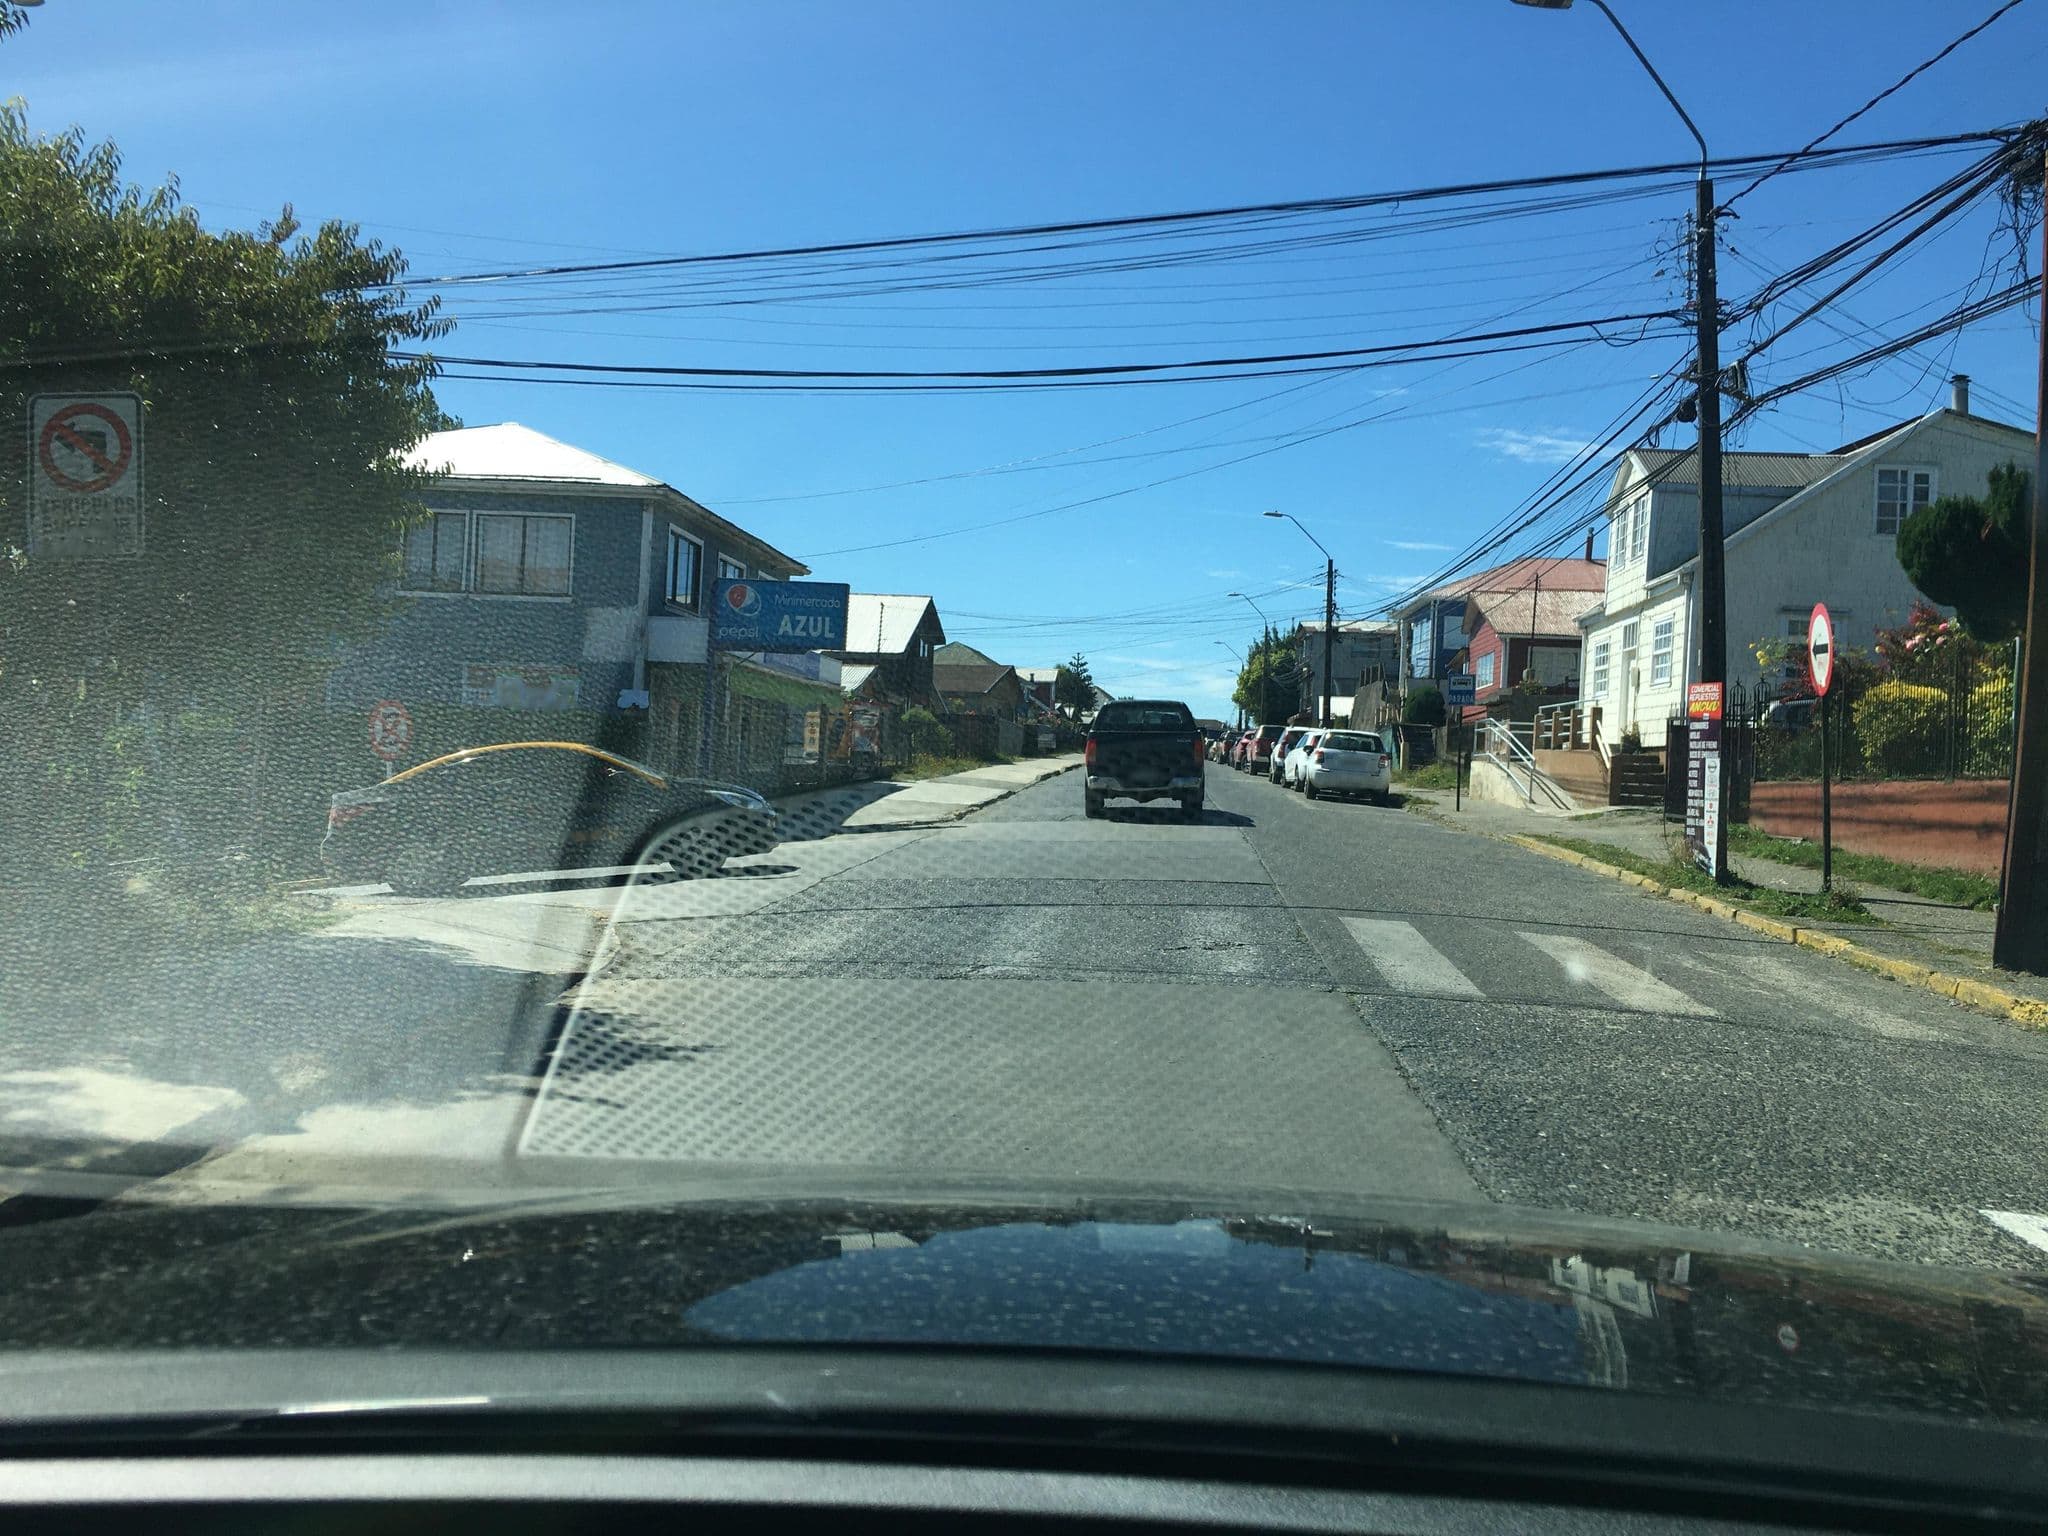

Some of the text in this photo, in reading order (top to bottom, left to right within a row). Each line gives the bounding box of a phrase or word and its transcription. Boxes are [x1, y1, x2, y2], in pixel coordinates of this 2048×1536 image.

[774, 593, 841, 609] Minimercado
[718, 624, 759, 640] pepsi
[777, 614, 836, 639] AZUL
[1690, 683, 1720, 693] COMERCIAL
[1689, 692, 1720, 702] REPUESTOS
